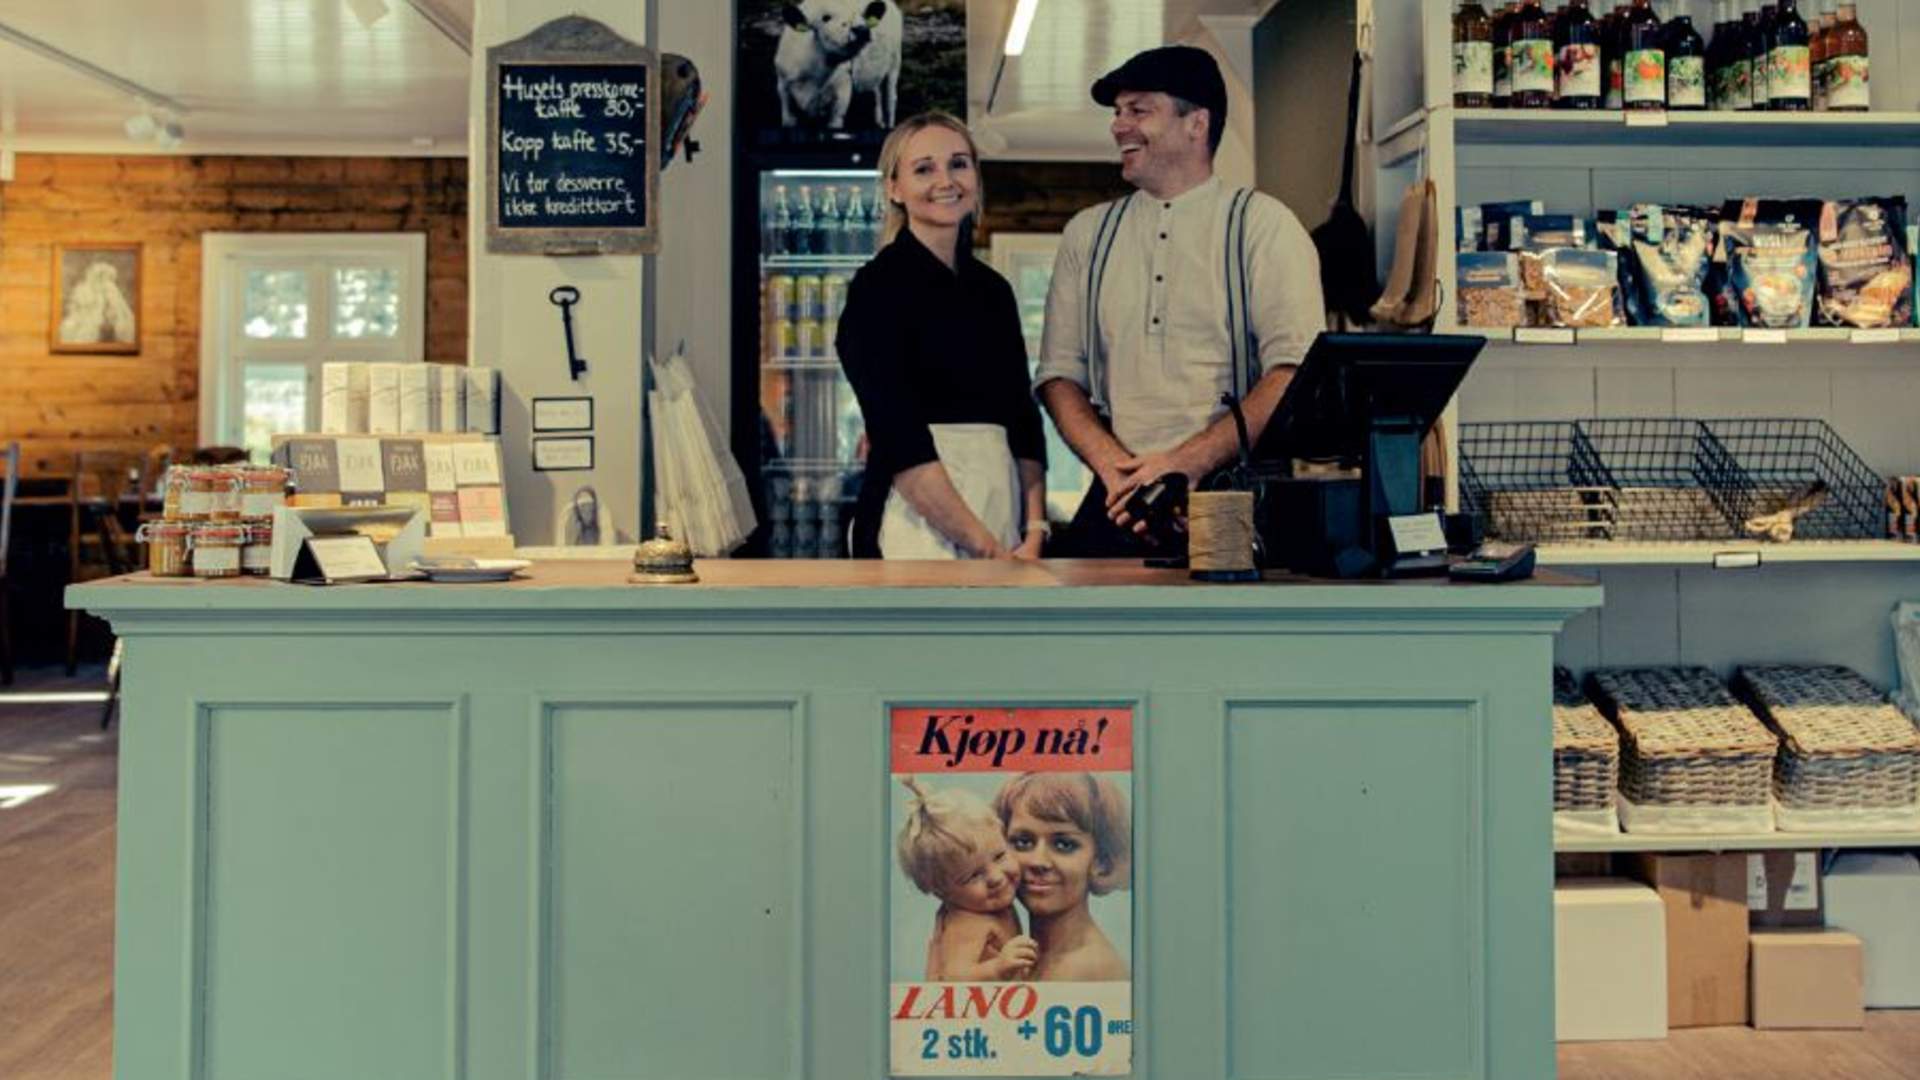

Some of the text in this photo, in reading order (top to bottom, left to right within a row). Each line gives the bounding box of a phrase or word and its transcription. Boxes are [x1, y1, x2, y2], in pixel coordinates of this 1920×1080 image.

[535, 97, 584, 118] kaffe
[502, 128, 645, 161] Kopp kaffe 35,-
[502, 171, 520, 193] Vi
[526, 171, 549, 194] tar
[504, 197, 538, 216] ikke
[915, 714, 1109, 767] Kjøp nå!
[892, 984, 1037, 1021] LANO
[921, 1028, 939, 1059] 2
[946, 1027, 997, 1059] stk.
